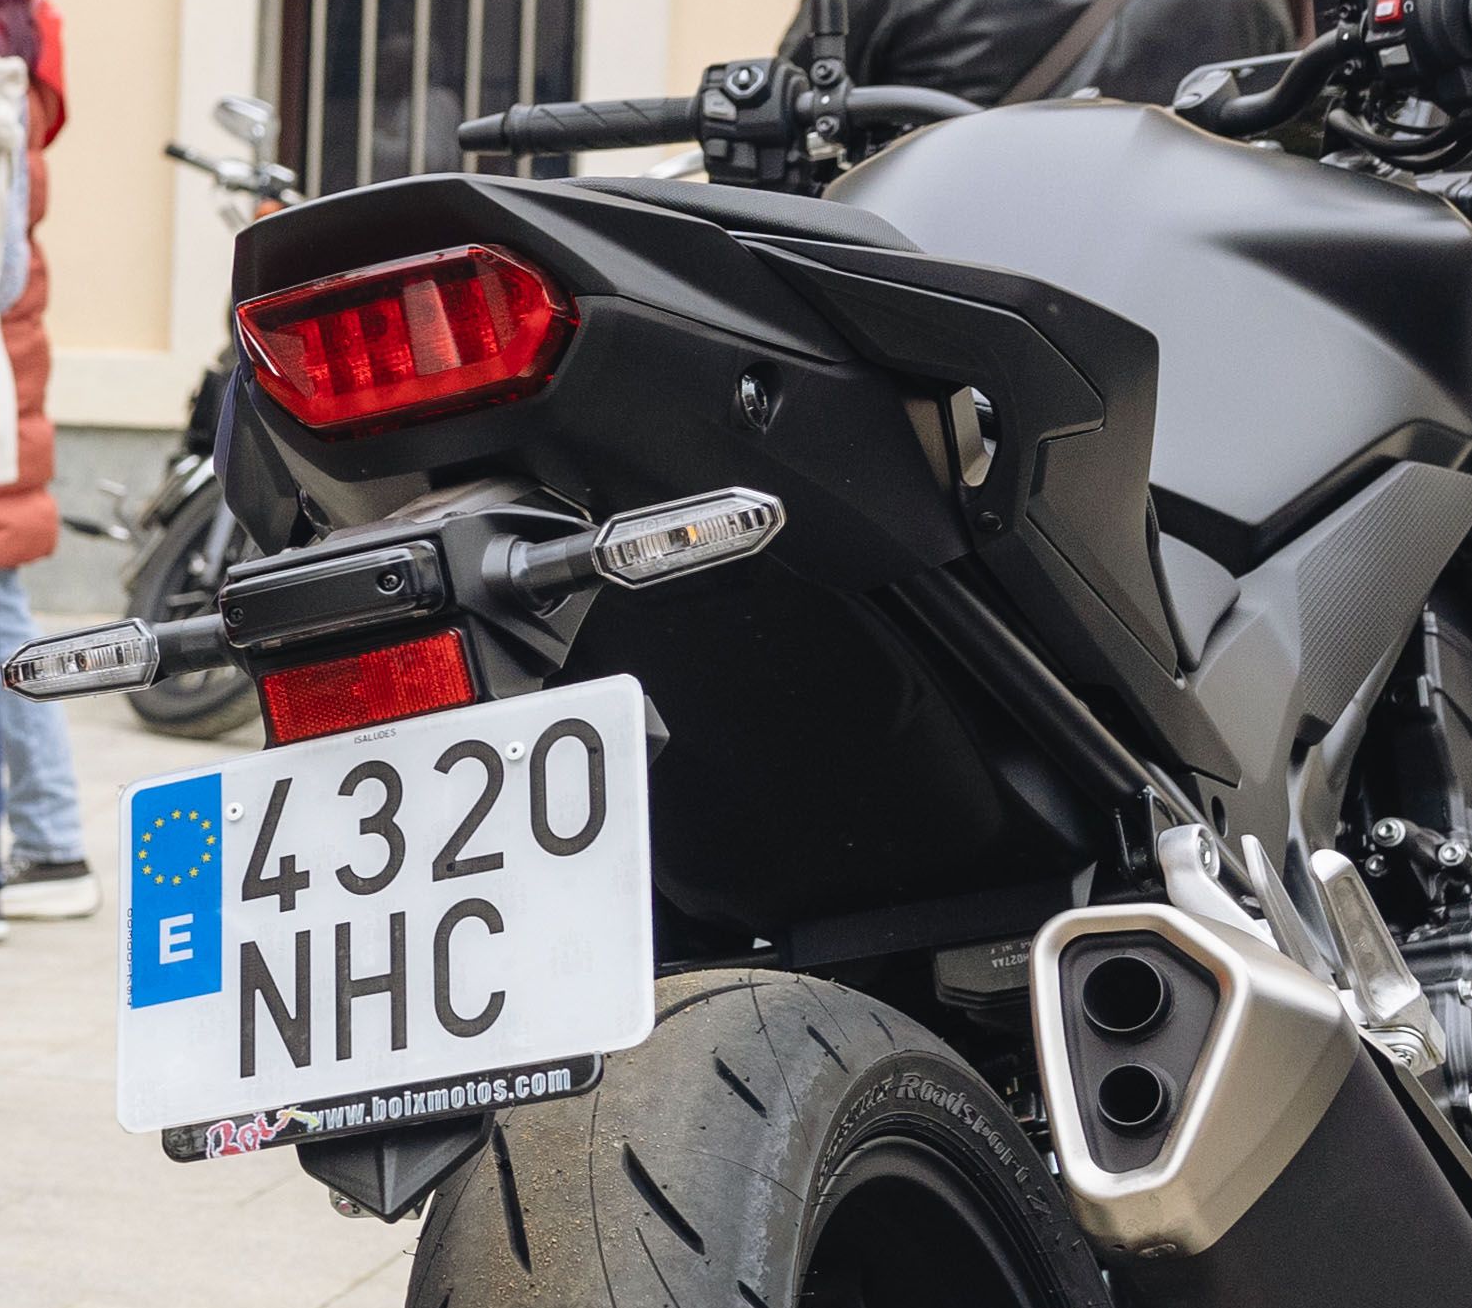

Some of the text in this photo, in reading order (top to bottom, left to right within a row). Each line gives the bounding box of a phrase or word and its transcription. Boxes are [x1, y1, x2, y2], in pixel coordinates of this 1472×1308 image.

[241, 718, 607, 912] 4320
[159, 913, 194, 965] E
[239, 898, 506, 1079] NHC
[309, 1066, 571, 1131] www.boixmotos.com
